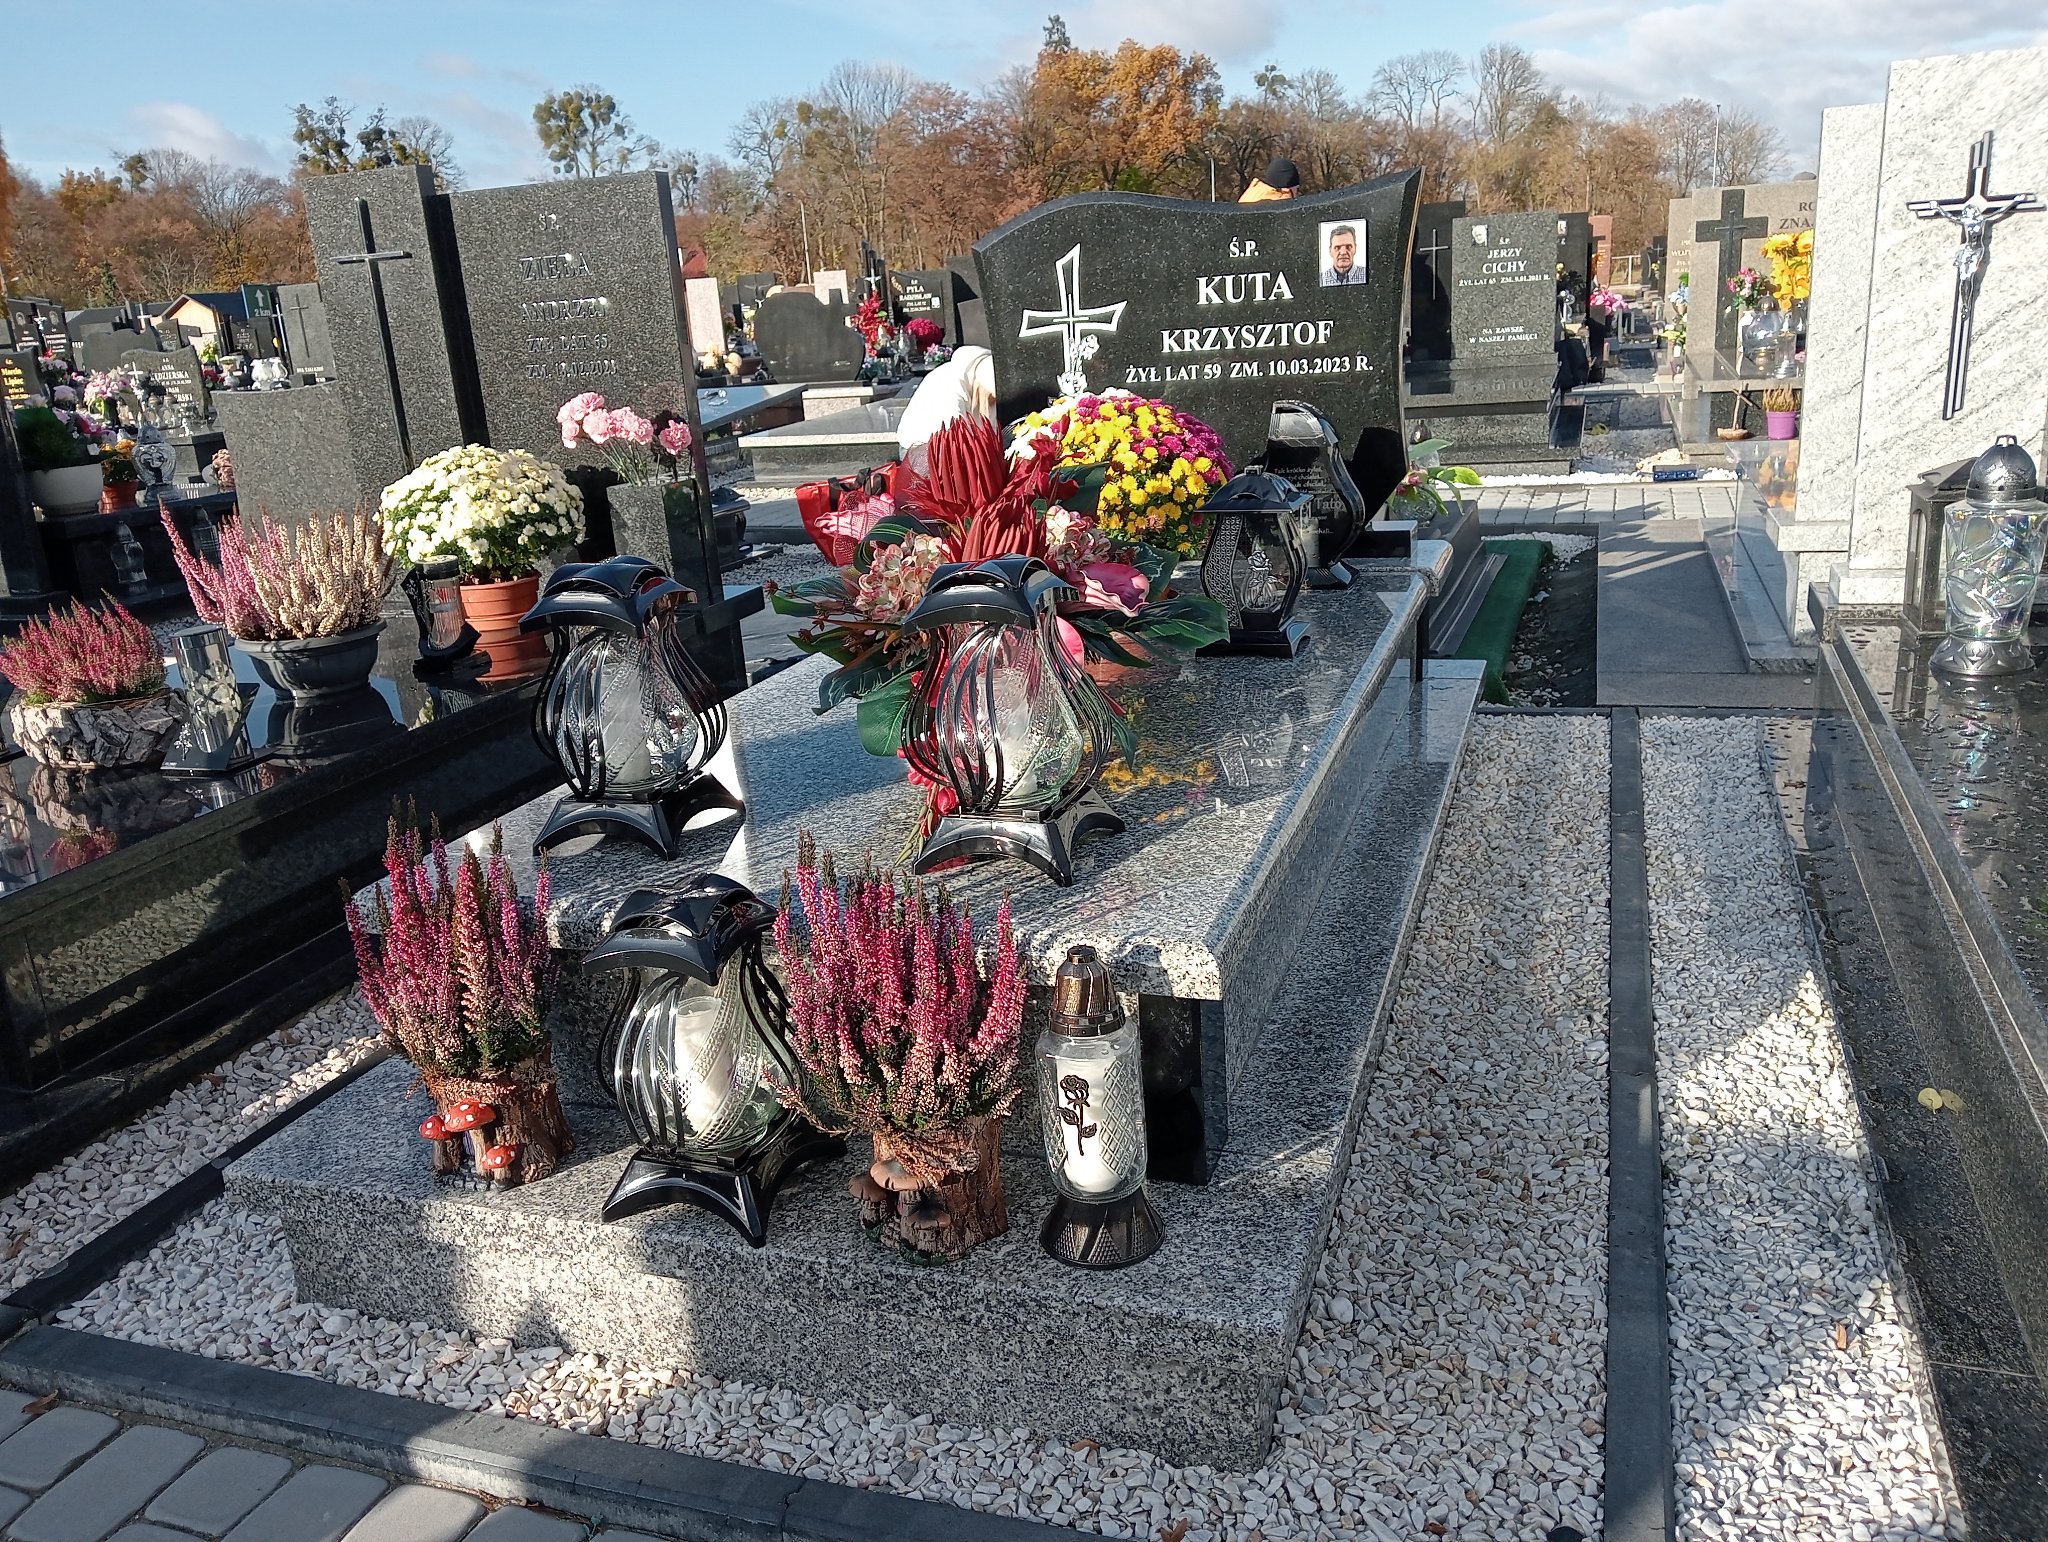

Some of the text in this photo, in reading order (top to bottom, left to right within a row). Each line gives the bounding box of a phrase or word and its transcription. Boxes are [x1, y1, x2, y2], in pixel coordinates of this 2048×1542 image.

[1779, 217, 1815, 230] ZNA
[1228, 236, 1260, 258] Ś.P.
[1487, 247, 1522, 259] JERZY
[1482, 260, 1527, 274] CICHY
[1195, 271, 1295, 306] KUTA
[254, 308, 271, 317] 2 km
[1160, 319, 1335, 354] KRZYSZTOF
[1125, 354, 1375, 384] ŻYŁ LAT 59 ZM. 10.03.2023 R.
